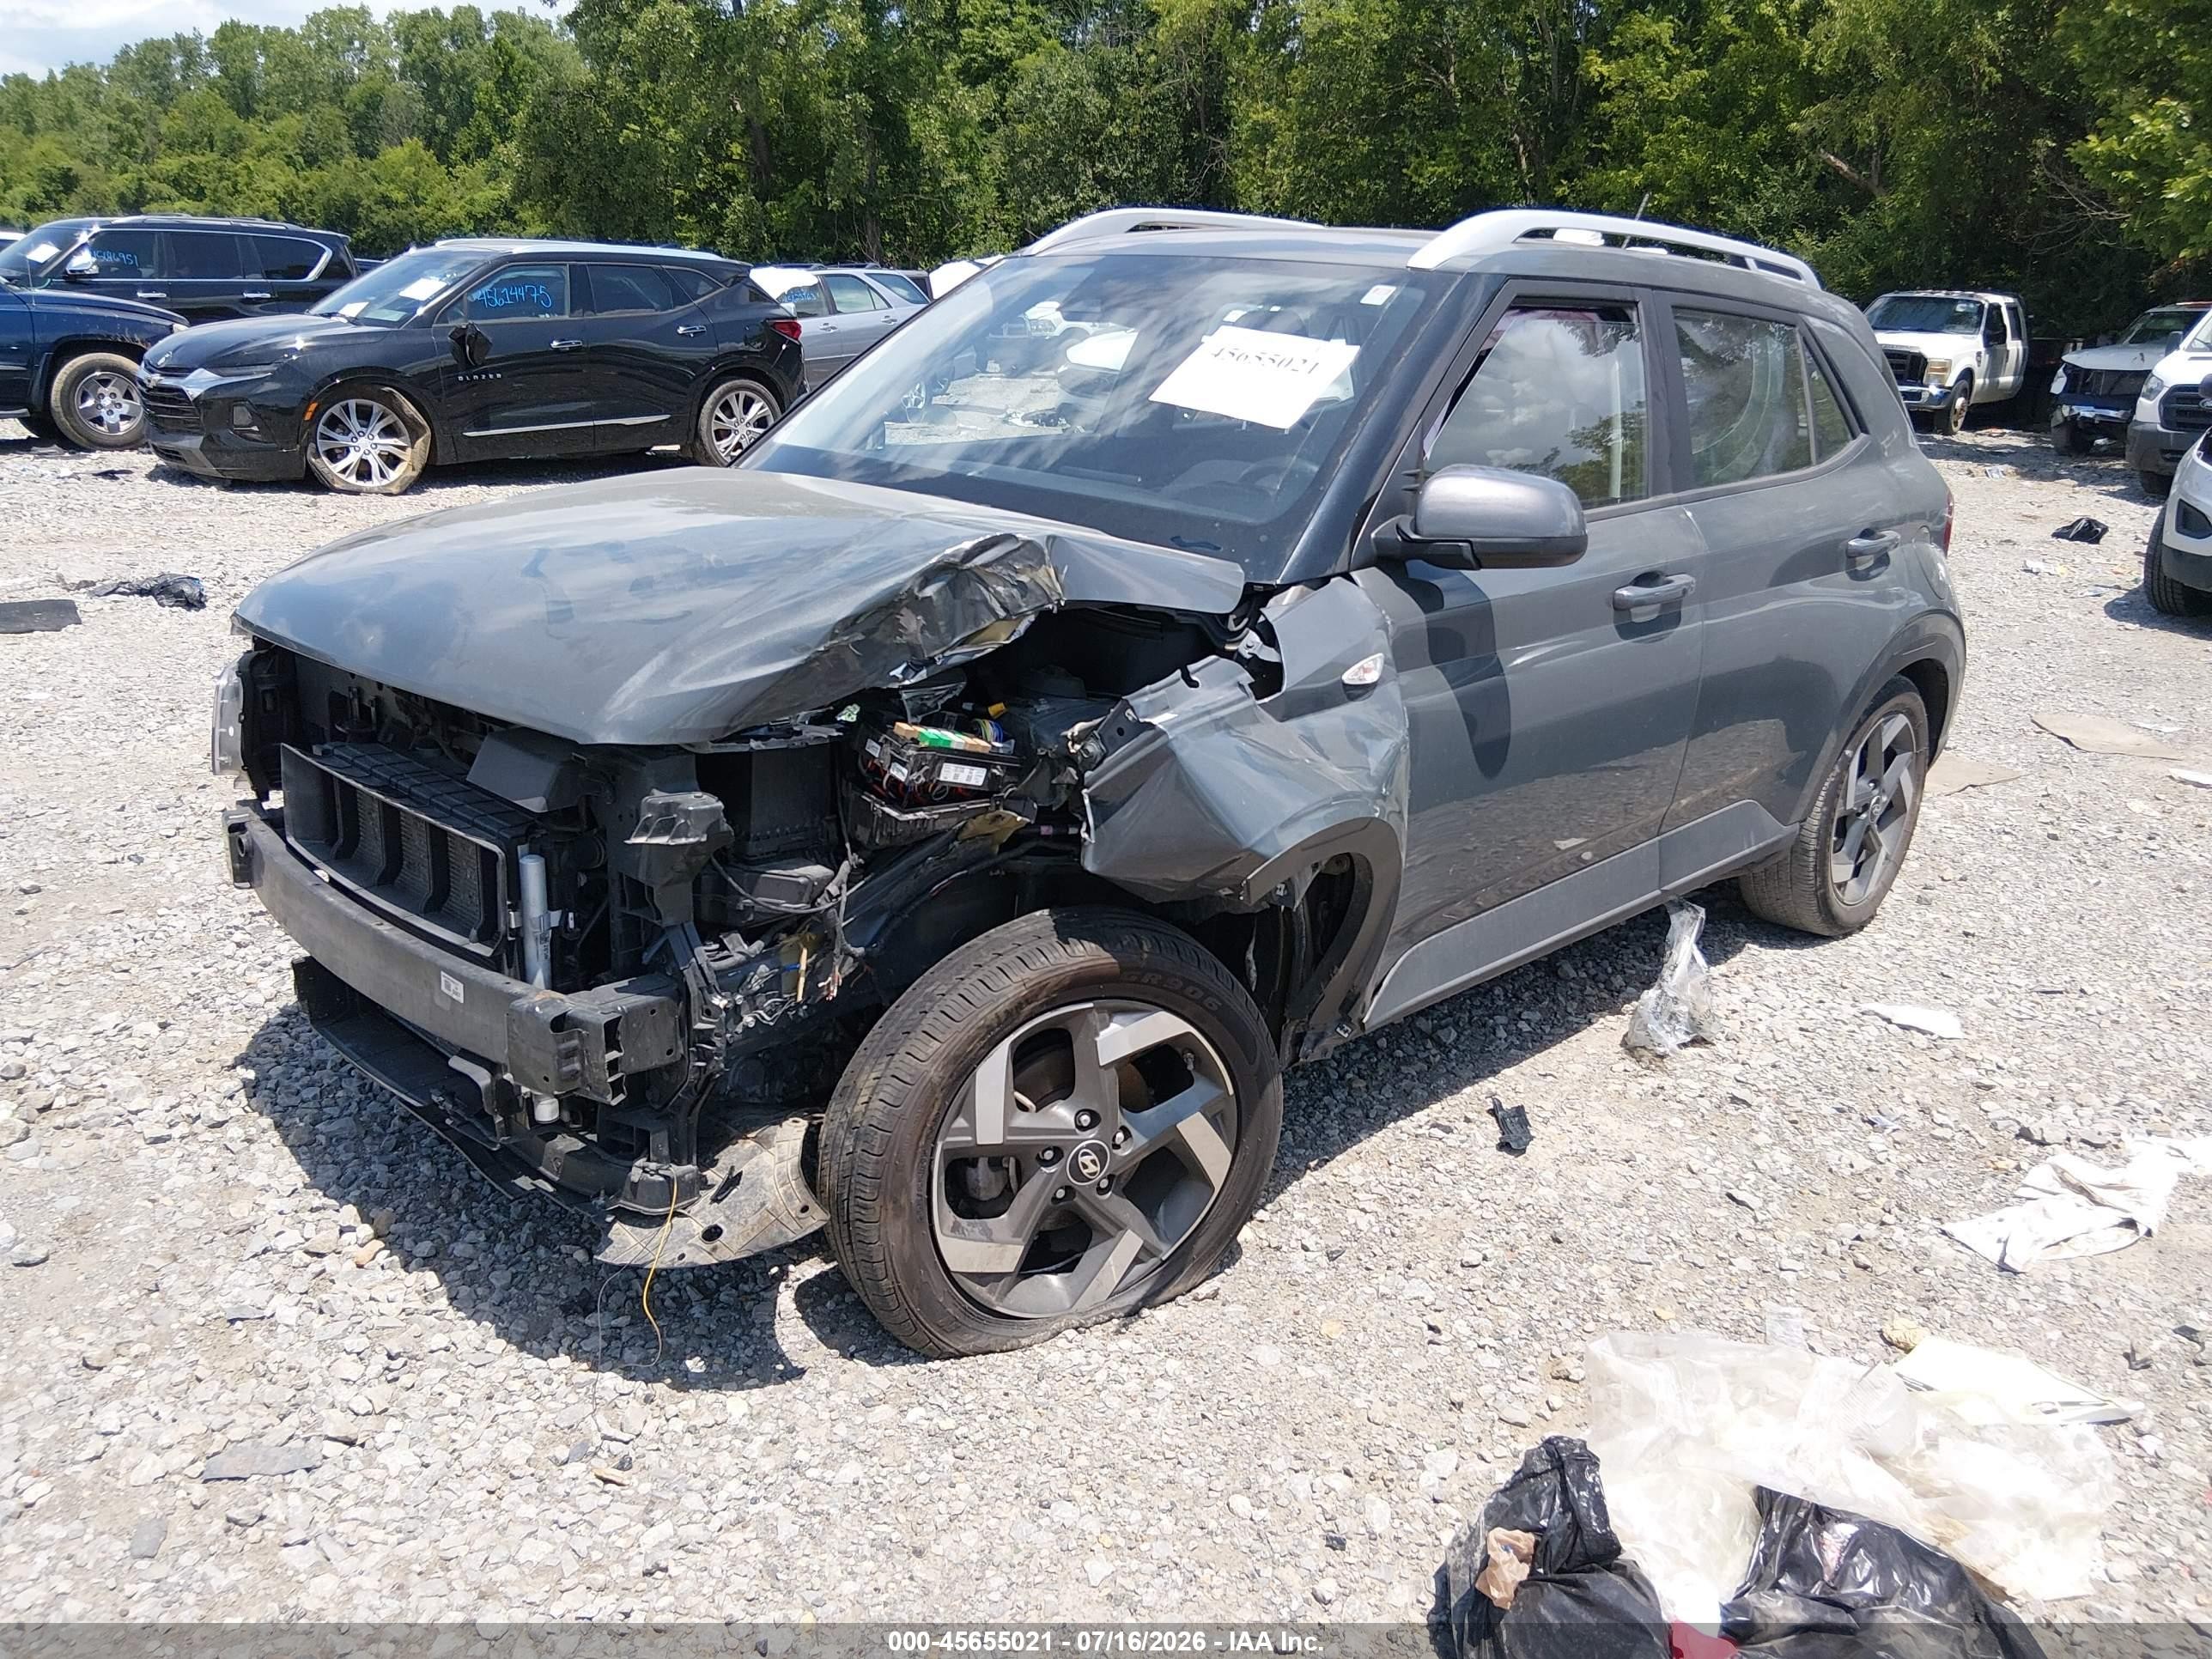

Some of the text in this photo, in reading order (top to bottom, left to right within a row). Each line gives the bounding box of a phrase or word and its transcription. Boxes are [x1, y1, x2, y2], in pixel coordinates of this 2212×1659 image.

[477, 284, 552, 308] 45614475
[1211, 347, 1320, 375] 45655021
[458, 373, 501, 381] BLAZER
